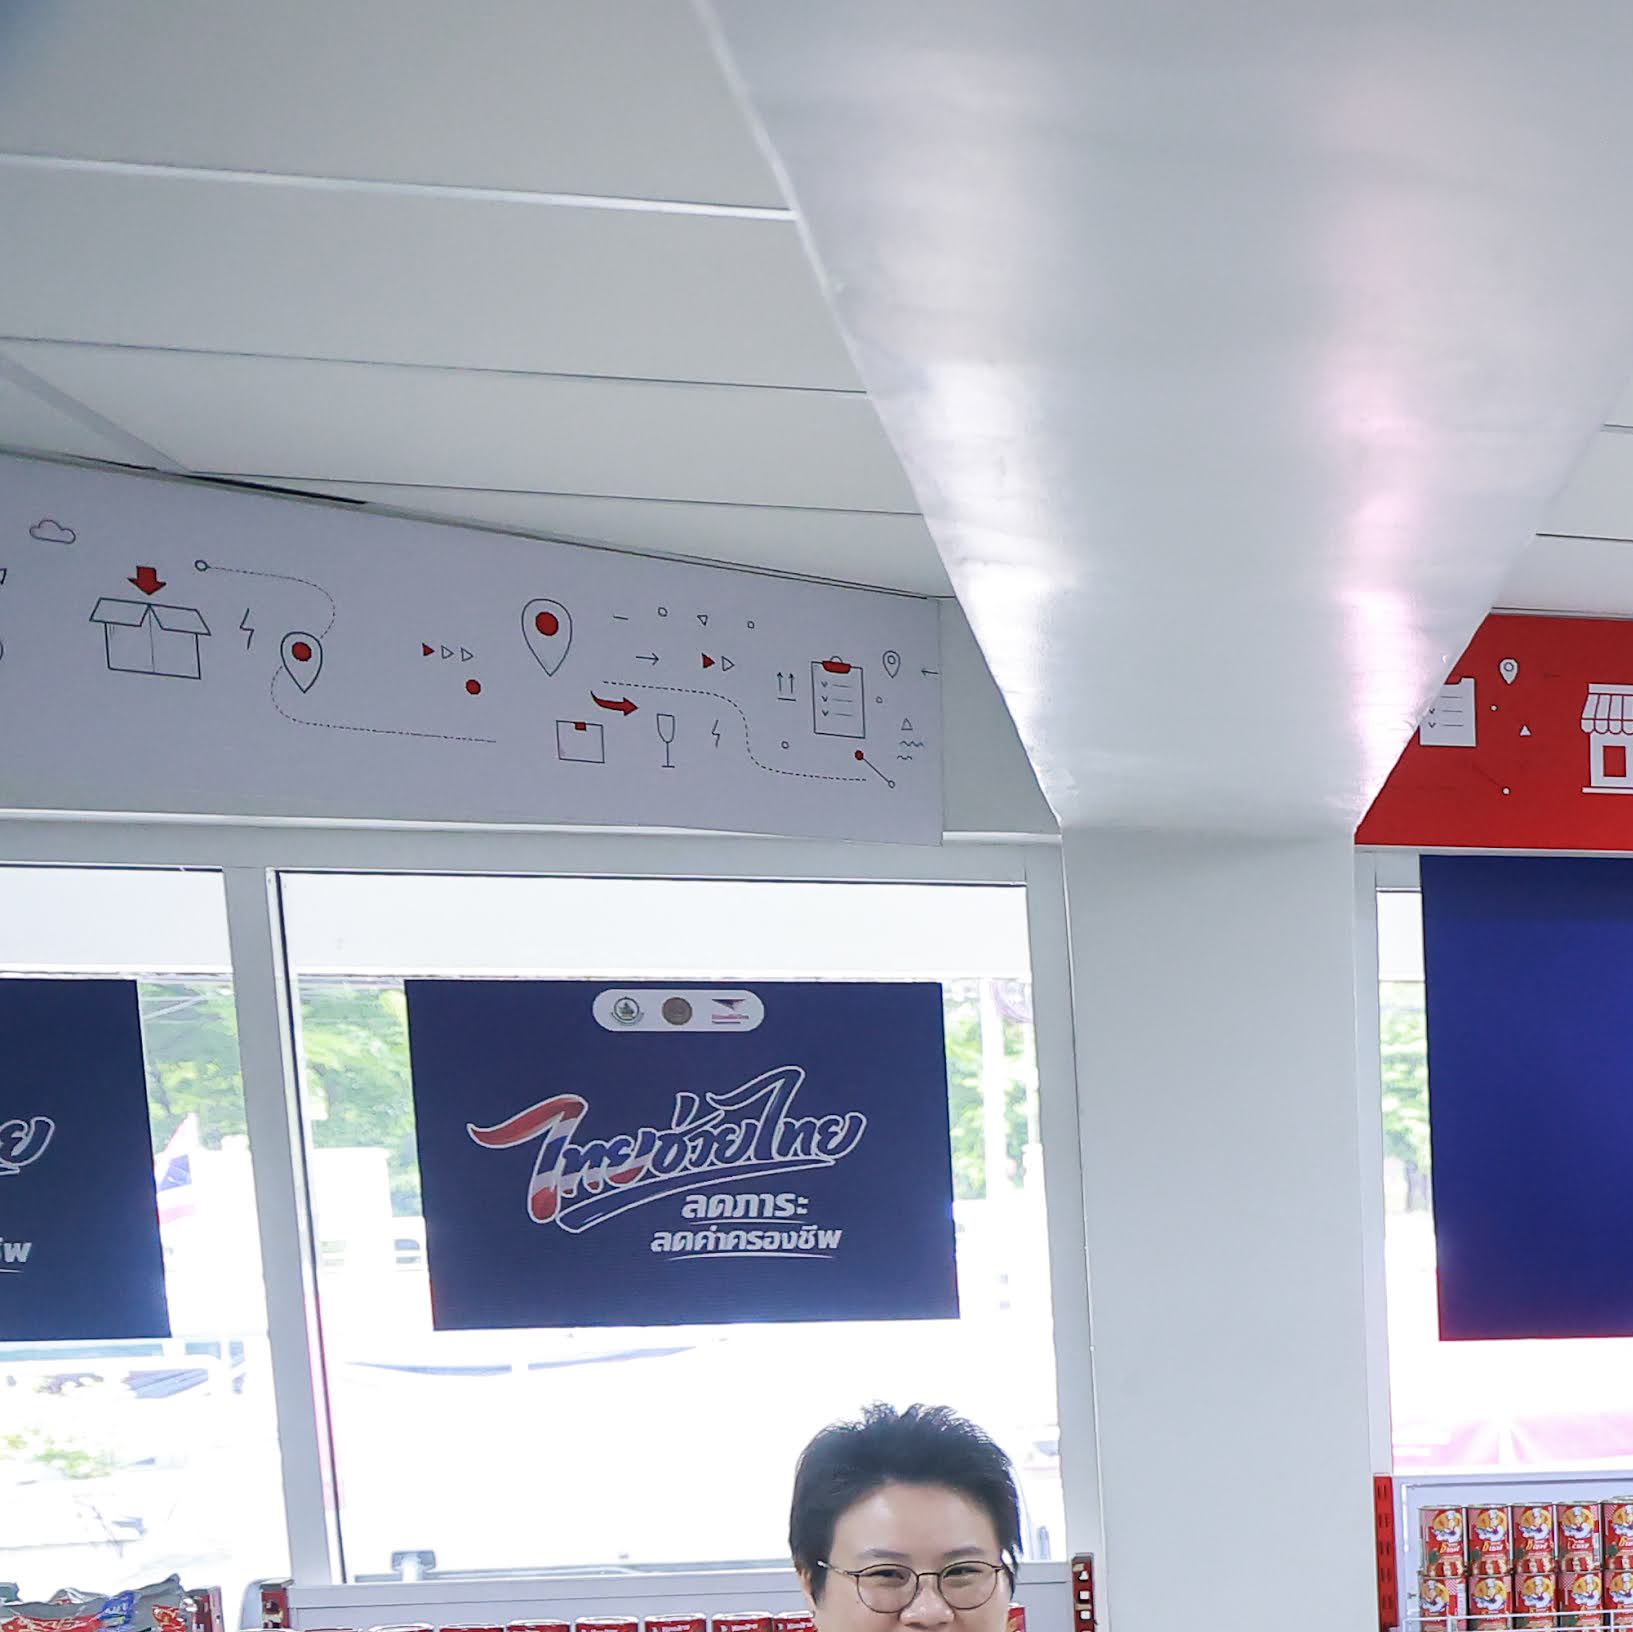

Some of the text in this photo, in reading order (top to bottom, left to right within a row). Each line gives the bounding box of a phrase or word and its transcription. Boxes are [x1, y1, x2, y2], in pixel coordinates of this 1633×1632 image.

[680, 1188, 810, 1222] ลดภาระ
[649, 1224, 844, 1256] ลดค่าครองชีพ
